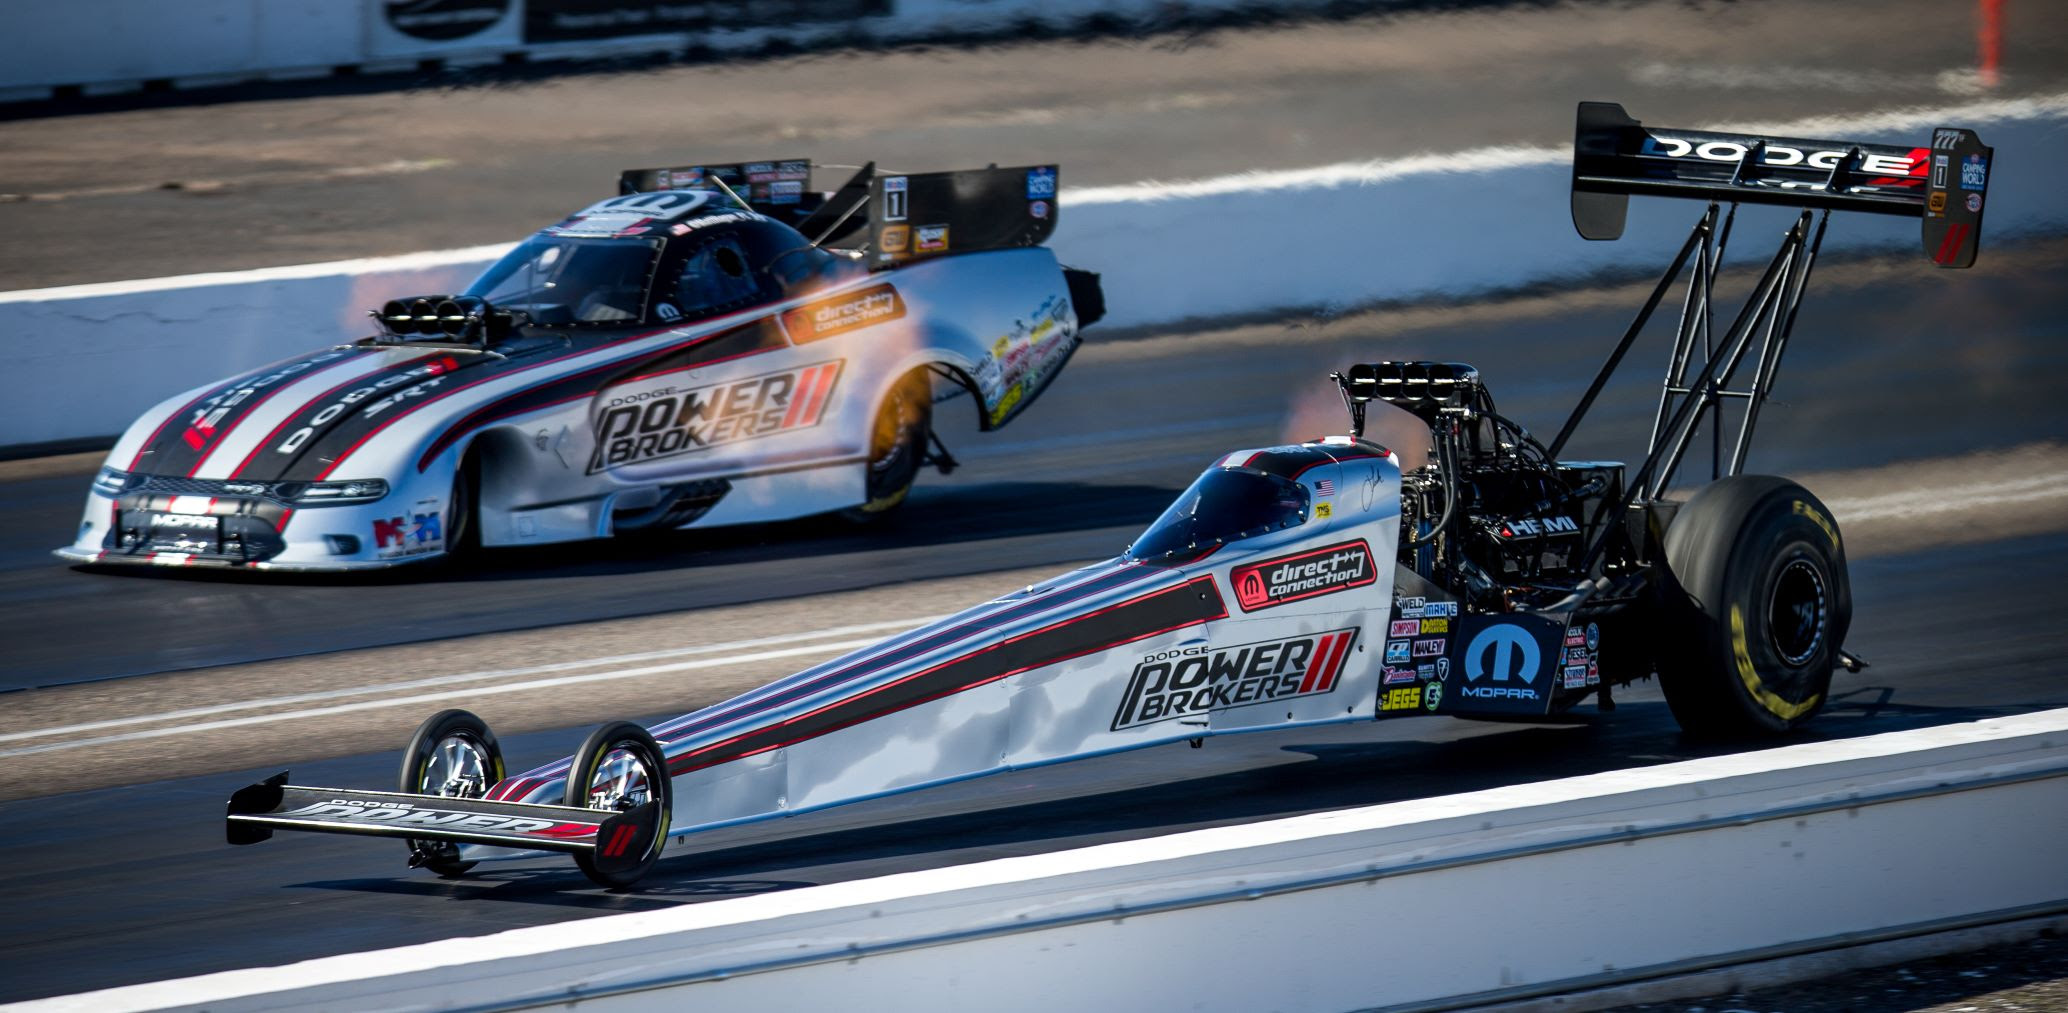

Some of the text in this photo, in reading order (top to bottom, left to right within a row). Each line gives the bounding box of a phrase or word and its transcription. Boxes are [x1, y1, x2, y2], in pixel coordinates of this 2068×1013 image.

[1934, 130, 1959, 149] 777
[1655, 138, 1914, 176] DODGE
[1937, 168, 1943, 185] 1
[1962, 163, 1985, 174] CAMPING
[1962, 173, 1984, 185] WORLD
[890, 192, 899, 216] 1
[815, 294, 882, 321] direct
[815, 306, 894, 332] connection
[364, 376, 448, 419] SRT
[611, 387, 677, 407] DODGE
[277, 363, 442, 454] DODGE
[598, 373, 796, 468] POWER
[608, 408, 787, 463] BROKERS
[151, 514, 219, 529] MOPAR
[1506, 516, 1578, 535] HEMI
[1271, 552, 1347, 584] direct
[1269, 567, 1362, 597] connection
[1402, 598, 1424, 610] WELD
[1392, 622, 1418, 635] SIMPSON
[1144, 646, 1208, 664] DODGE
[1414, 640, 1442, 655] MANLEY
[1119, 638, 1314, 726] POWER
[1137, 671, 1306, 722] BROKERS
[1383, 688, 1421, 710] JEGS
[1462, 687, 1535, 699] MOPAR
[331, 799, 415, 809] DODGE
